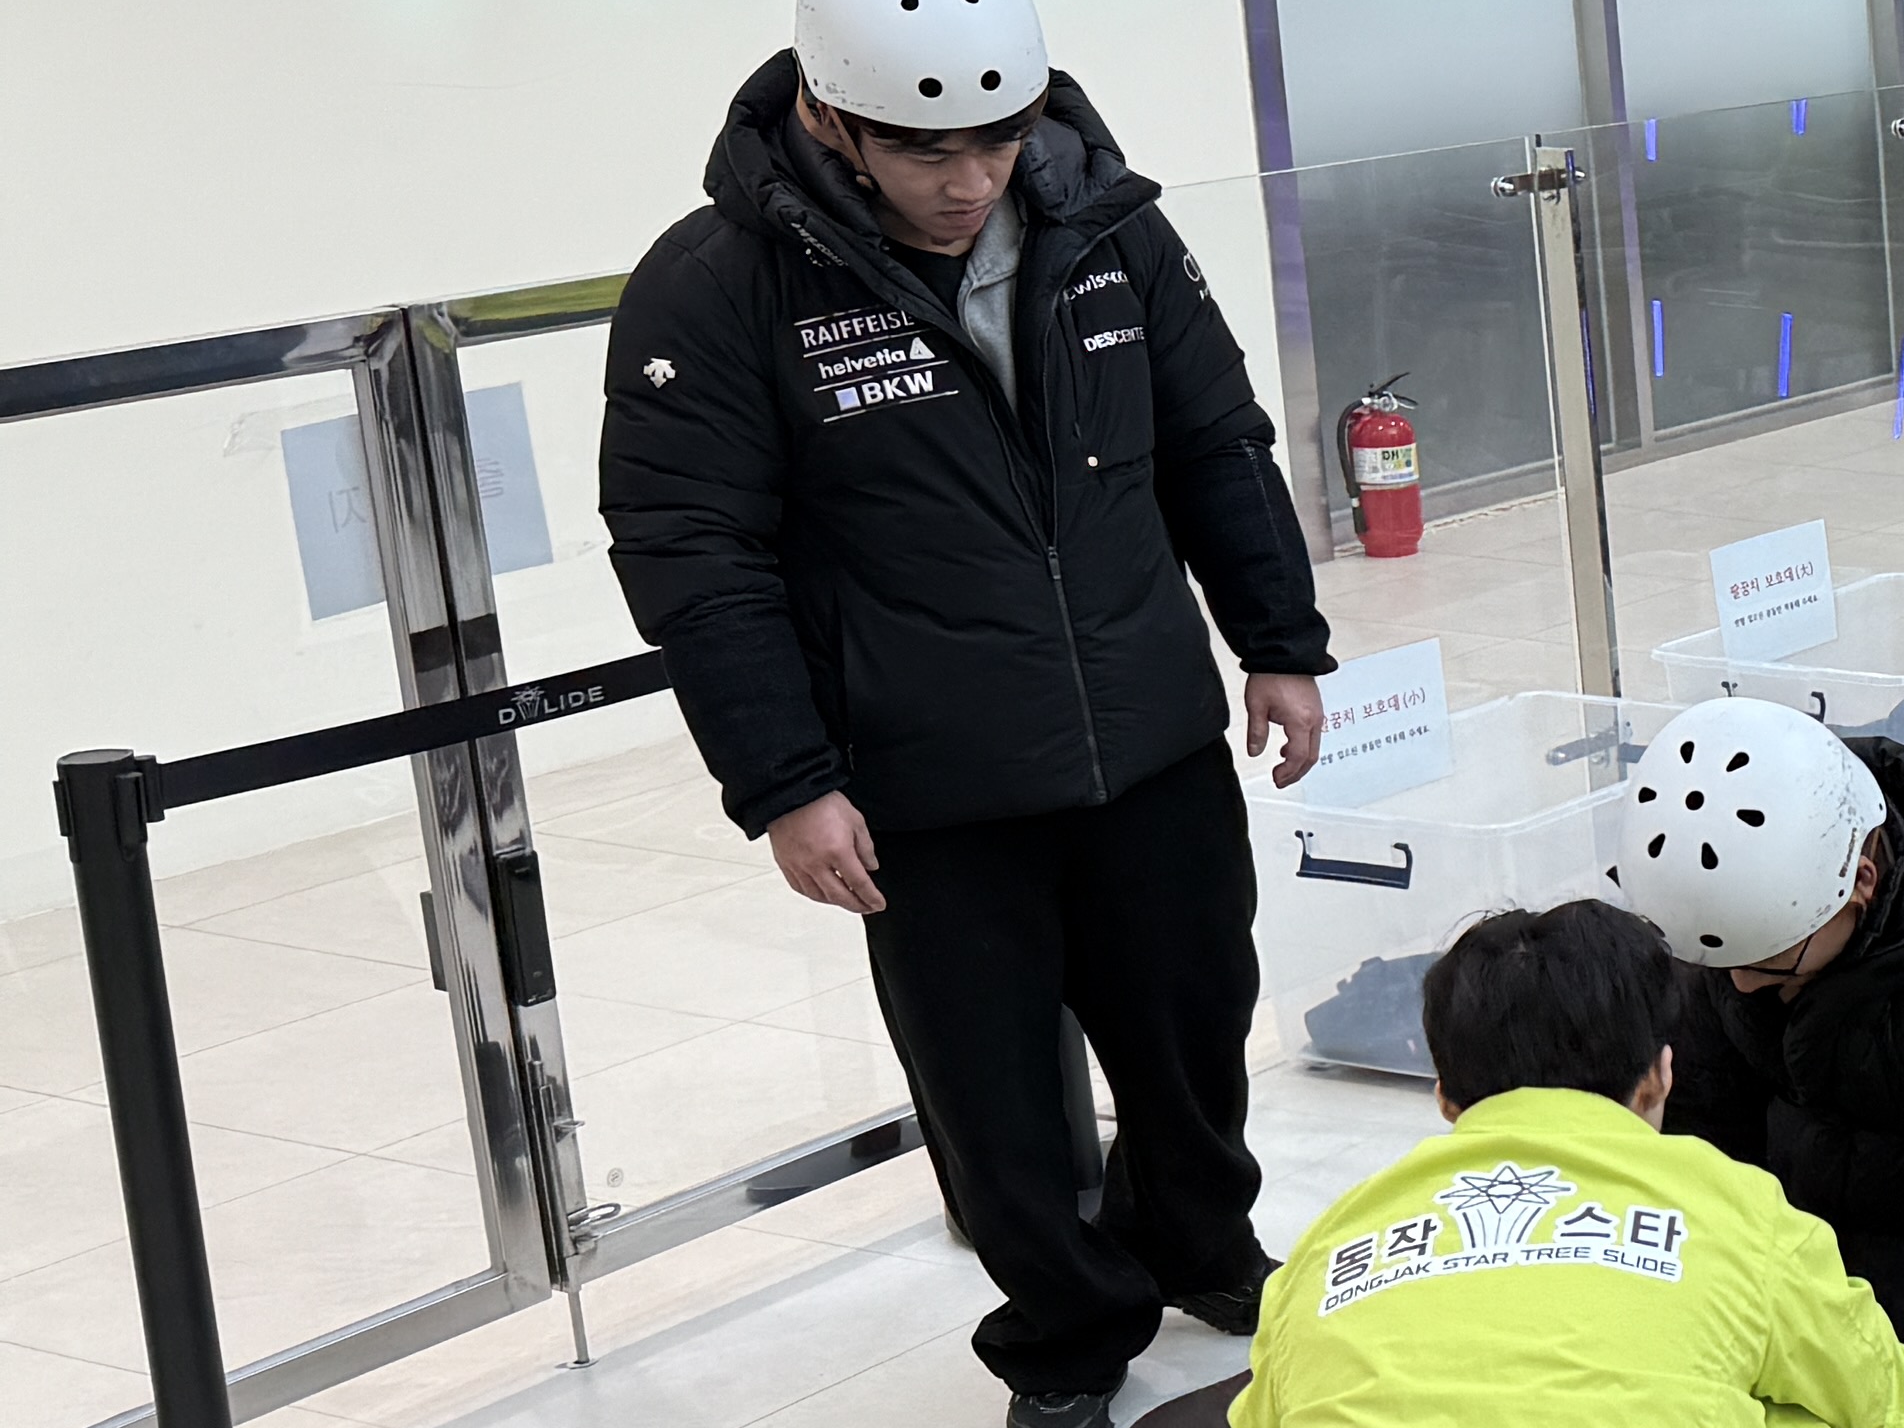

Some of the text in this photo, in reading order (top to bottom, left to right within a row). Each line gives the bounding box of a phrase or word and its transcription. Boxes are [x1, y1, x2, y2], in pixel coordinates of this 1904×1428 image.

[818, 348, 907, 380] helvetia
[861, 370, 934, 405] BKW
[498, 685, 605, 725] D LIDE
[1331, 1206, 1682, 1288] 동작 스타
[1324, 1245, 1678, 1311] DONGJAK STAR TREE SLIDE
